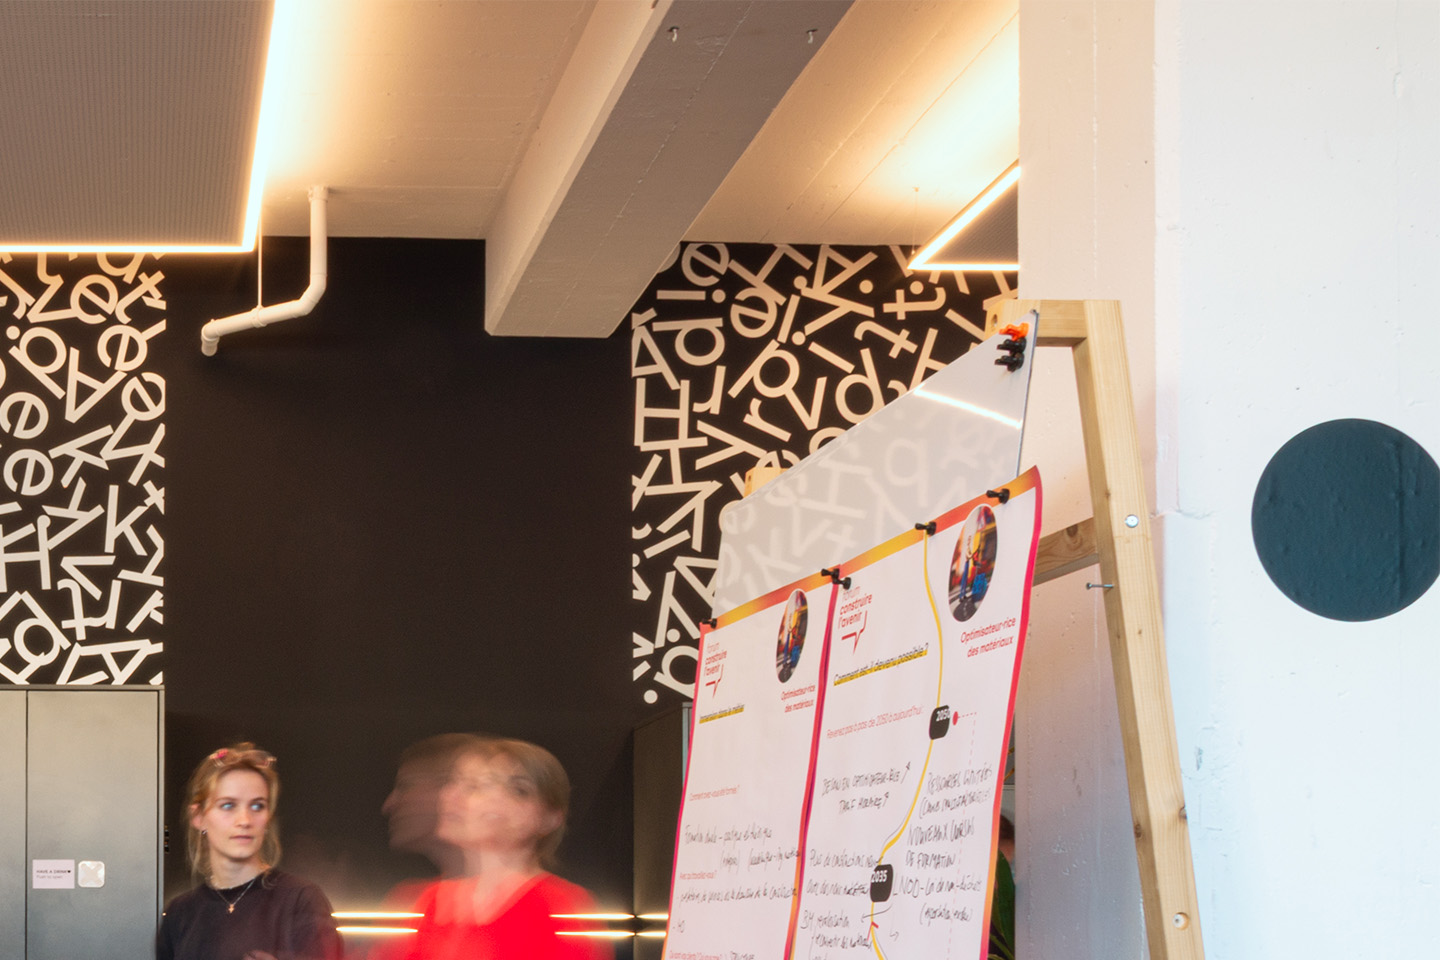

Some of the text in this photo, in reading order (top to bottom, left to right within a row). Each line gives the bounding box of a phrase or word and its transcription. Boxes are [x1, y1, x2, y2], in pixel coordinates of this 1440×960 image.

[840, 594, 872, 615] construire
[838, 610, 862, 628] l'avenir
[967, 636, 1013, 657] des matériaux
[705, 651, 727, 664] construire
[833, 669, 859, 686] Comment
[896, 646, 923, 665] possible
[917, 852, 956, 869] FORMATION
[871, 870, 888, 883] 2035
